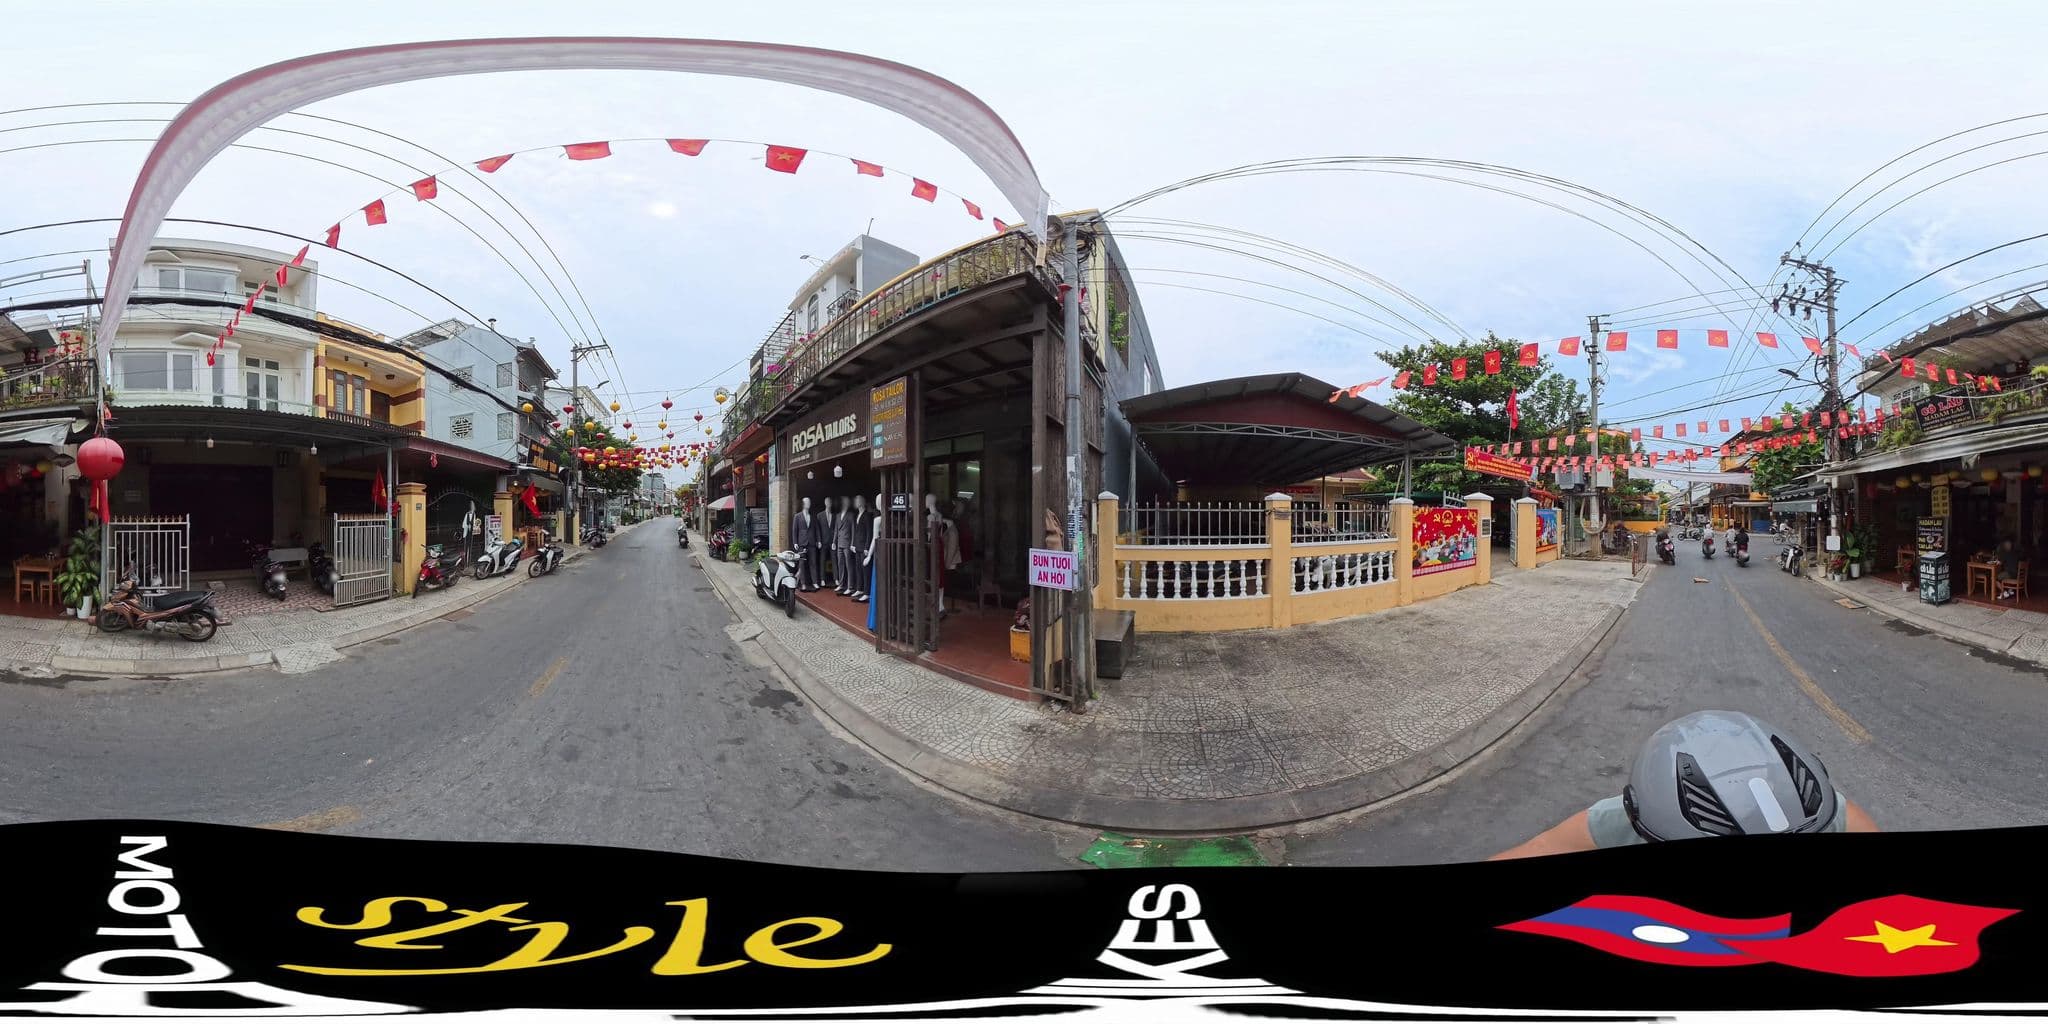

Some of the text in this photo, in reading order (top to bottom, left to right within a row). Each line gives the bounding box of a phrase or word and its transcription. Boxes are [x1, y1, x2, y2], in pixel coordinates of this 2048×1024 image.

[1924, 410, 1950, 421] MADAM
[792, 422, 825, 454] ROSA
[824, 413, 857, 441] TAILORS
[894, 496, 904, 505] 46
